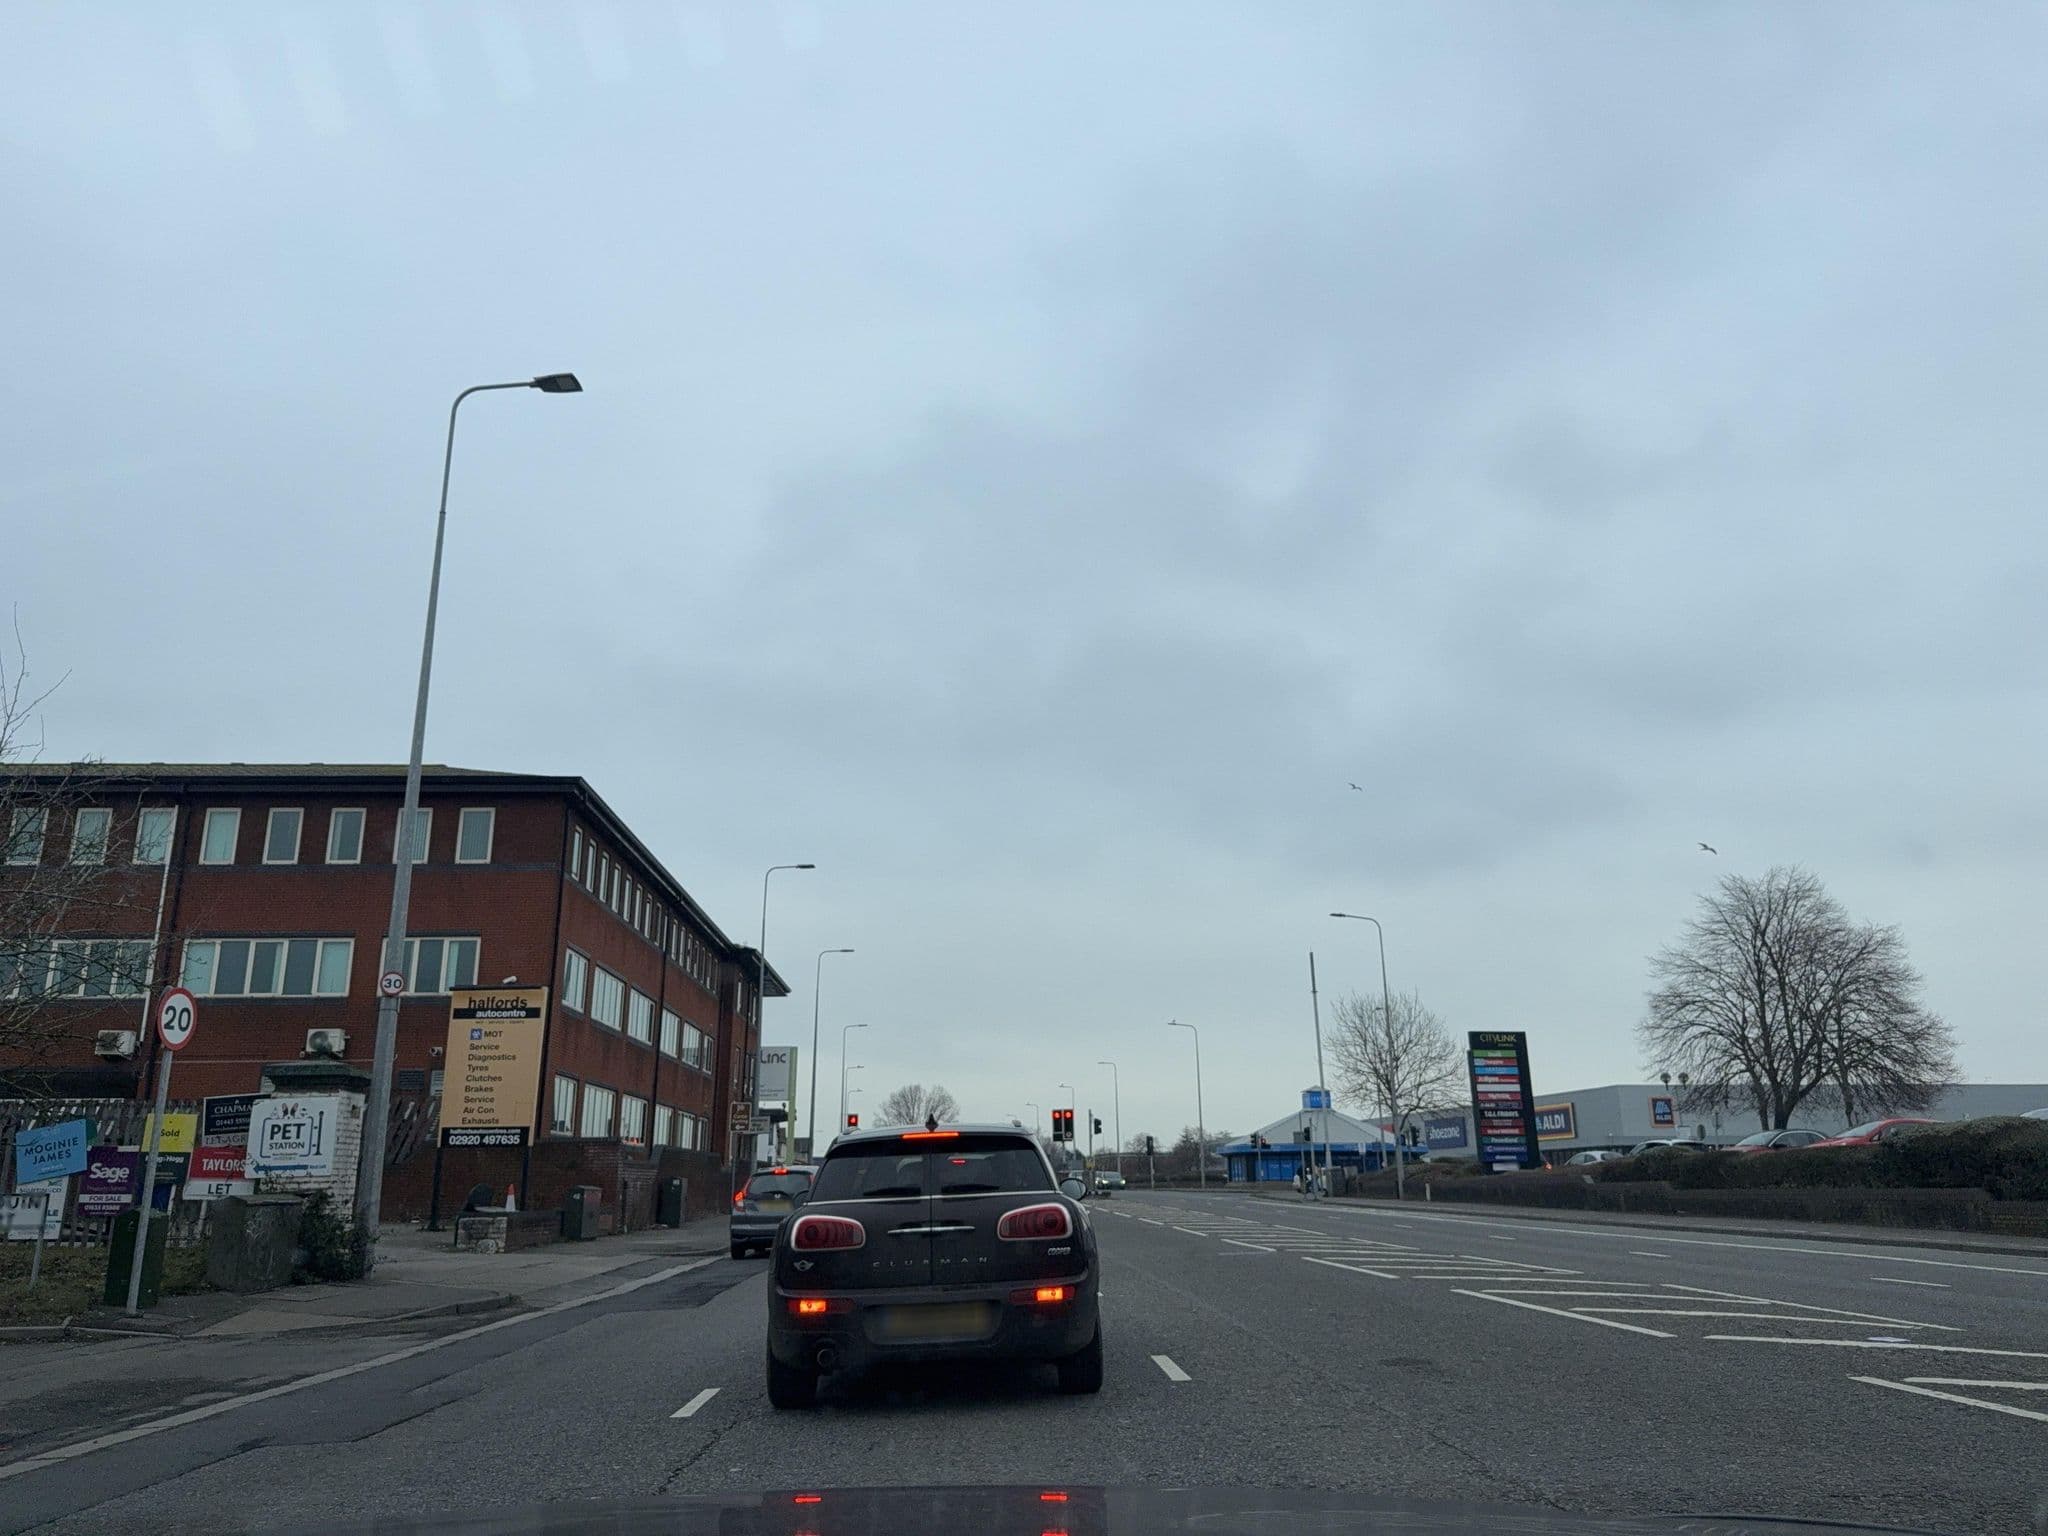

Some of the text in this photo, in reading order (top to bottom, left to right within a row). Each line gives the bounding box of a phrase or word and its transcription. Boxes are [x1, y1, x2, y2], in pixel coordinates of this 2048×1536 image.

[384, 979, 401, 988] 30
[468, 996, 527, 1009] halfords
[164, 1005, 191, 1032] 20
[475, 1010, 526, 1018] autocentre
[468, 1053, 517, 1062] Diagnostics
[467, 1064, 489, 1073] Tyres
[464, 1085, 494, 1093] Brakes
[214, 1105, 252, 1114] CHAPMA
[477, 1106, 494, 1114] Con
[462, 1117, 499, 1125] Exhausts
[1543, 1114, 1565, 1130] ALDI
[160, 1129, 180, 1137] Sold
[270, 1123, 306, 1140] PET
[449, 1135, 521, 1145] 02920 497635
[24, 1137, 79, 1157] MOGINIE
[269, 1142, 305, 1150] STATION
[32, 1149, 72, 1165] JAMES
[202, 1158, 246, 1171] TAYLORS
[89, 1163, 130, 1183] Sage
[207, 1184, 233, 1195] LET
